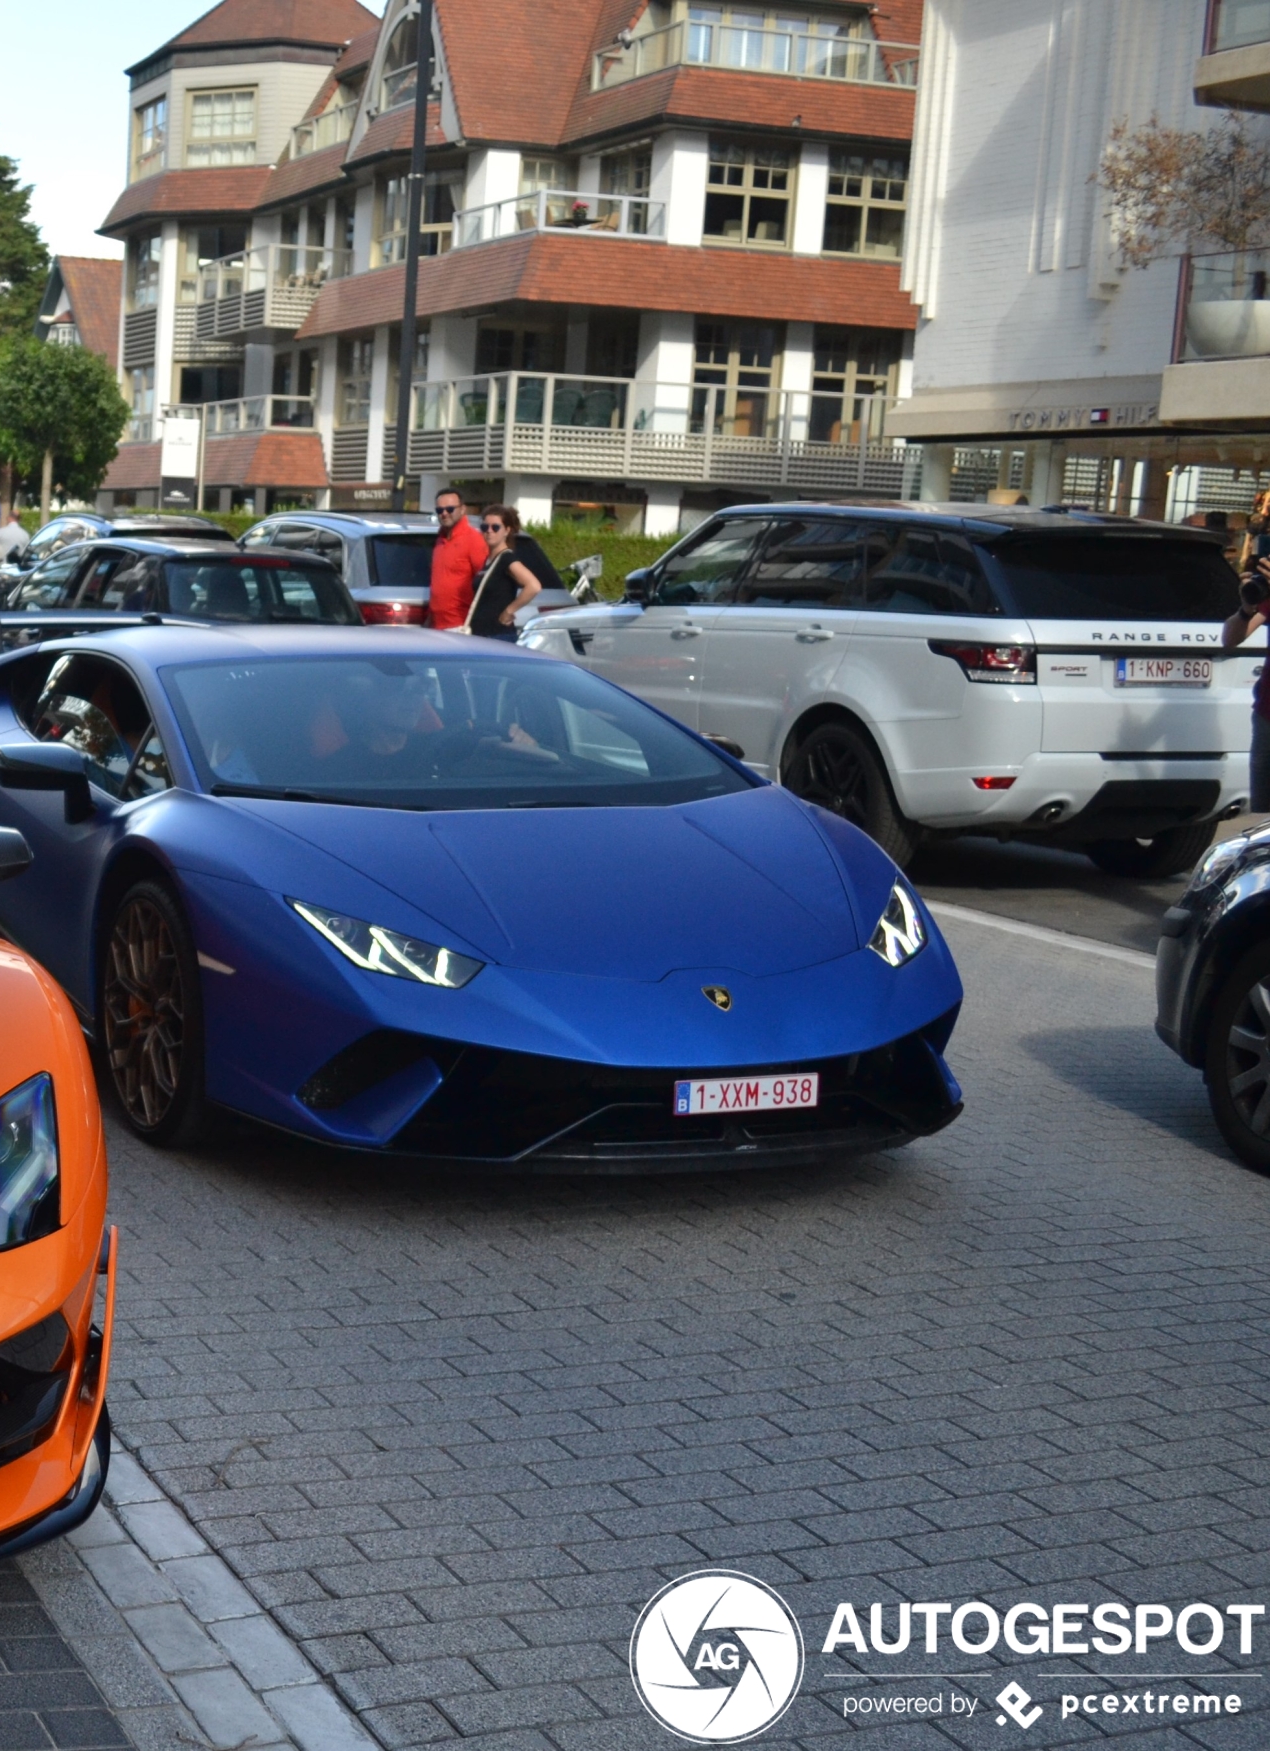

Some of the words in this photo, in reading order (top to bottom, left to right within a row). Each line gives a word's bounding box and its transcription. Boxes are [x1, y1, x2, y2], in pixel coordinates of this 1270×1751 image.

[1008, 408, 1086, 429] TOMMY
[1091, 632, 1167, 642] RANGE
[1050, 665, 1088, 673] SPORT
[1117, 669, 1125, 680] B
[1129, 660, 1211, 679] 1-KNP-660
[677, 1099, 688, 1112] B
[696, 1078, 813, 1110] 1-XXM-938
